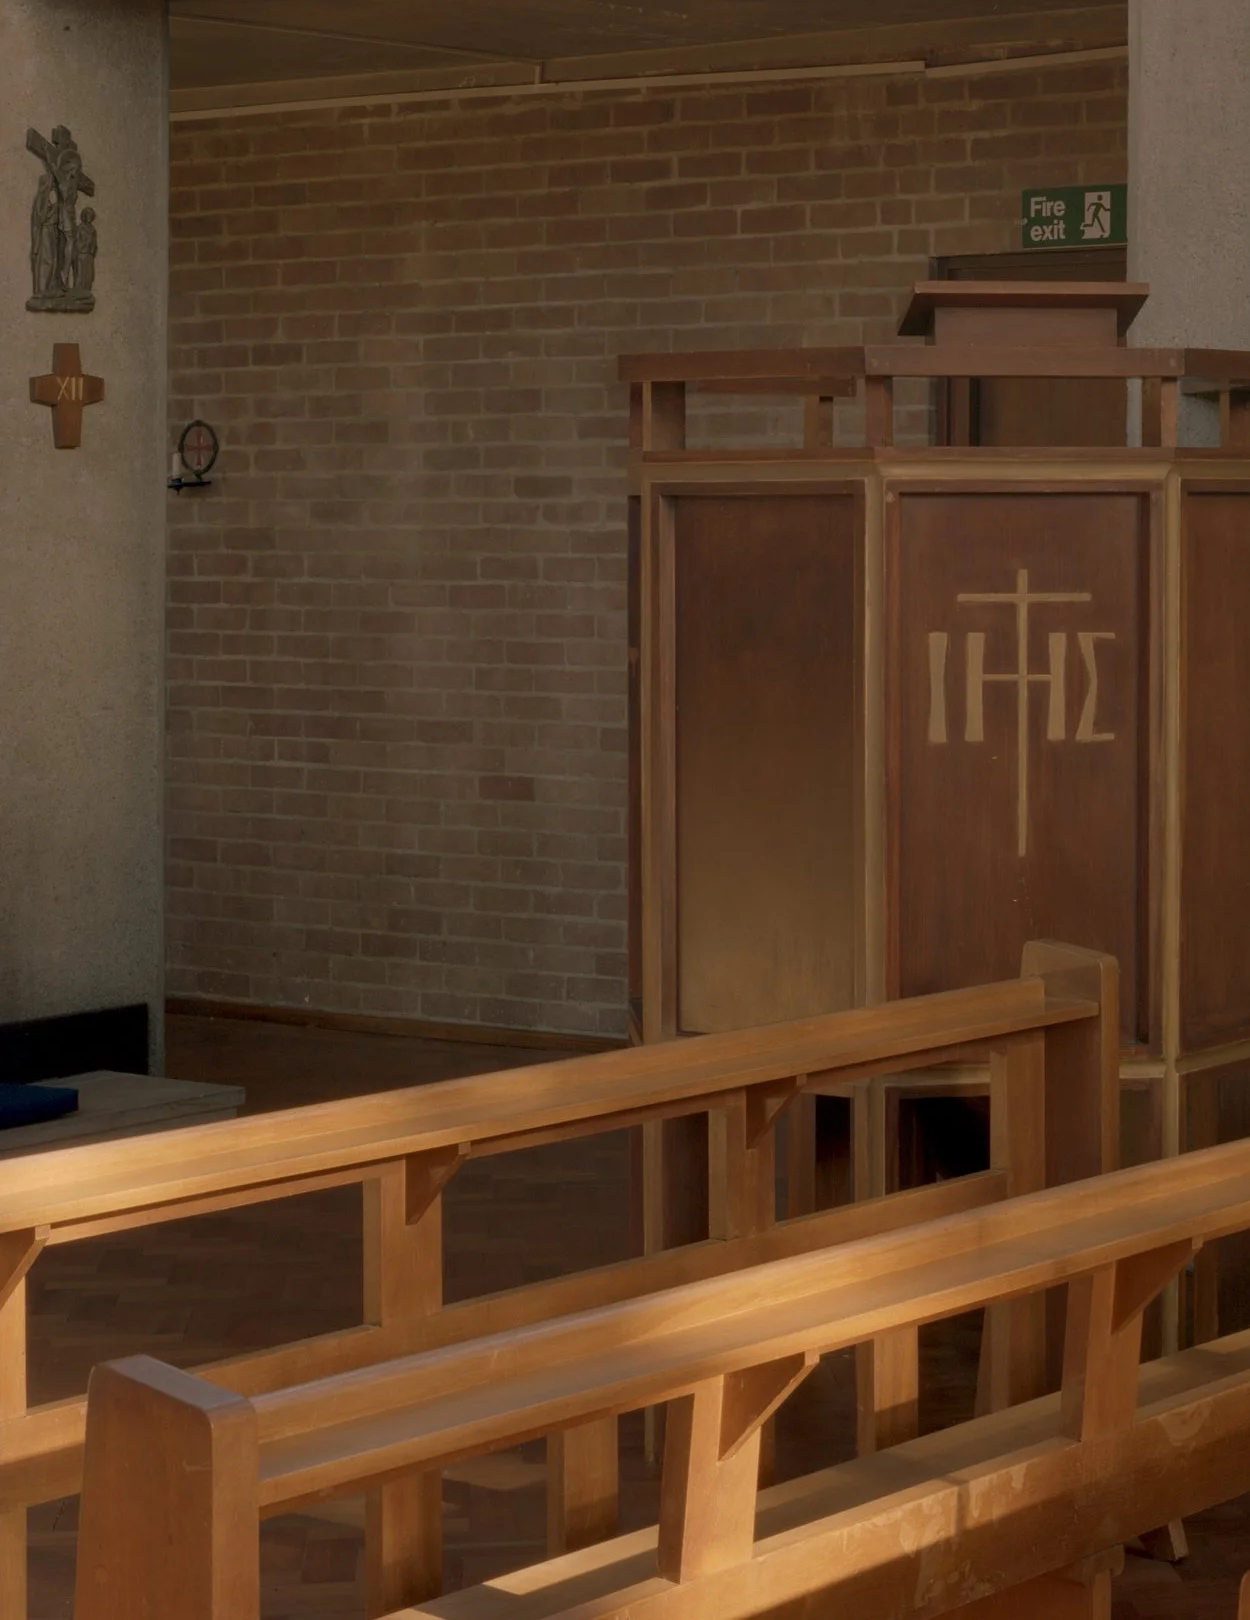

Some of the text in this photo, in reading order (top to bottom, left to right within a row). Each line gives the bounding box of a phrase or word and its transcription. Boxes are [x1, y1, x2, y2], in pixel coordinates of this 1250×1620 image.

[1030, 196, 1066, 218] Fire
[1030, 220, 1066, 242] exit
[56, 376, 84, 401] XII
